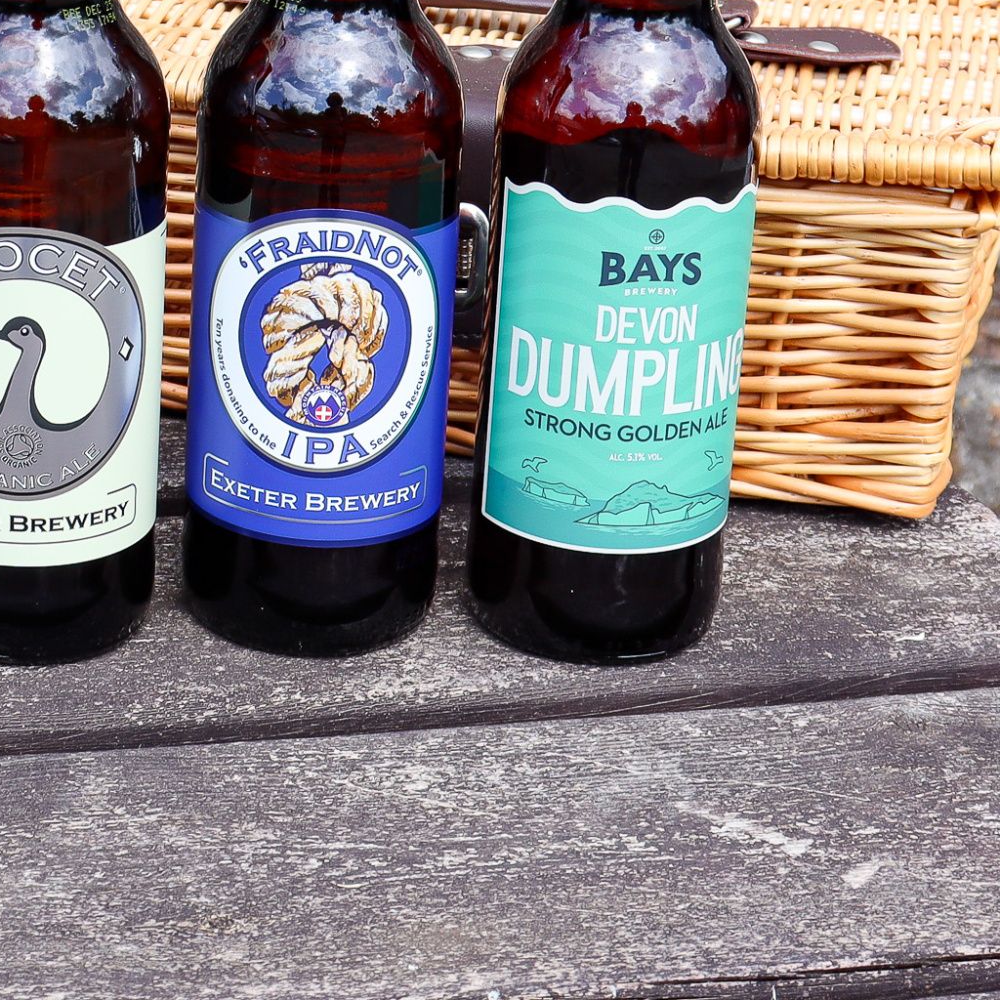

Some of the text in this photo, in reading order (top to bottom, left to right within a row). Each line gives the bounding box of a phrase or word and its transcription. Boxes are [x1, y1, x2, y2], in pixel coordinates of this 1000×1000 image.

[86, 4, 102, 16] DEC
[599, 251, 702, 286] BAYS
[624, 288, 678, 296] BREWERY
[594, 304, 699, 344] DEVON
[215, 318, 277, 450] Ten years donating to the
[369, 326, 433, 450] Search & Rescue Service
[524, 407, 728, 442] STRONG GOLDEN ALE
[60, 443, 102, 483] ALE
[281, 430, 369, 465] IPA
[211, 468, 422, 512] EXETER BREWERY
[9, 500, 130, 533] BREWERY
